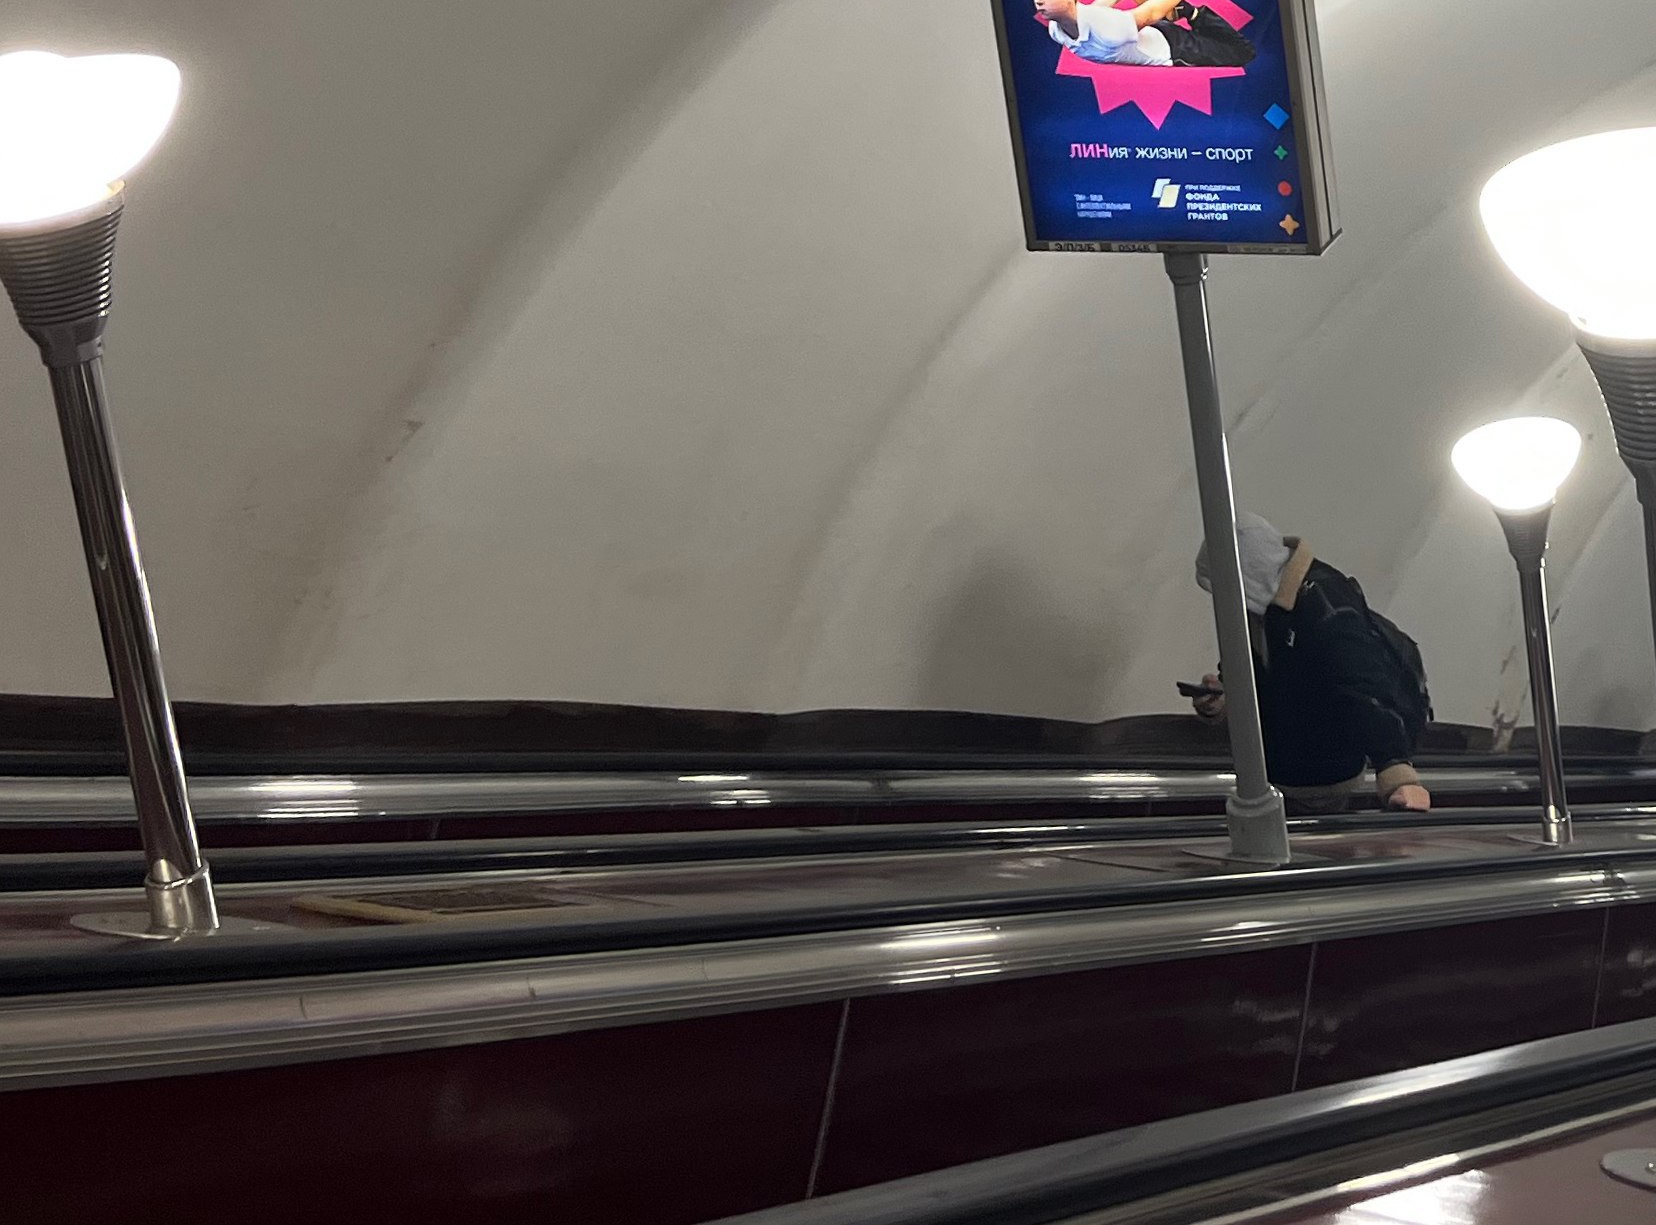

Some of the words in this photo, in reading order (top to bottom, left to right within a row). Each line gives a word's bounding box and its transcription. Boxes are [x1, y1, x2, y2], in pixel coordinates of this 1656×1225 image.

[1135, 147, 1188, 160] жизни
[1205, 147, 1254, 164] спорт
[1185, 192, 1220, 202] ФОНДА
[1186, 202, 1262, 212] ПРЕЗИДЕНТСКИХ
[1187, 212, 1229, 221] ГРАНТОВ
